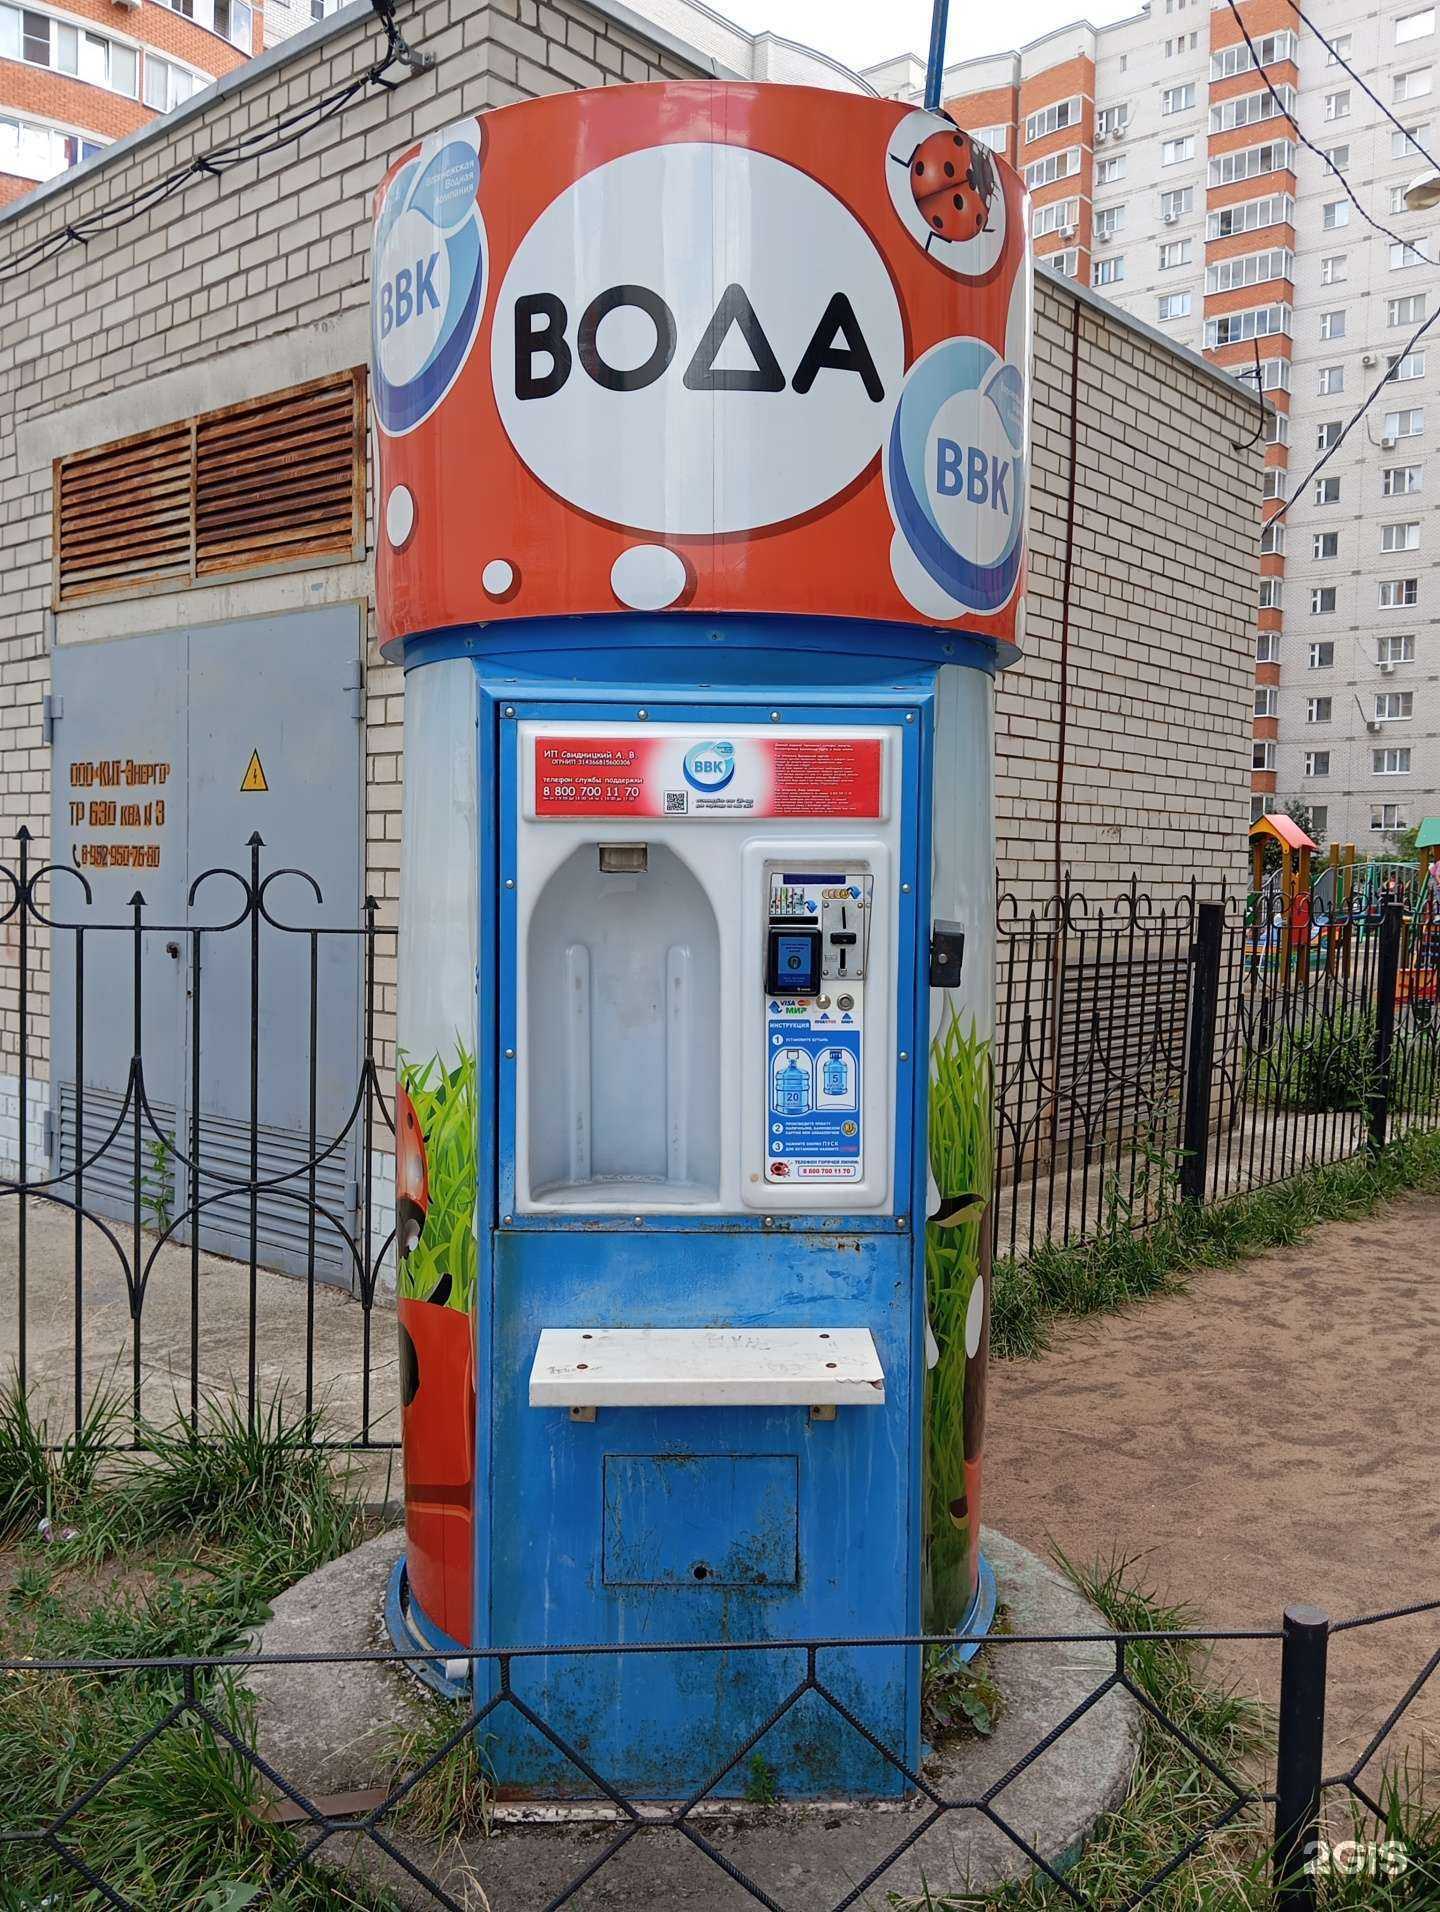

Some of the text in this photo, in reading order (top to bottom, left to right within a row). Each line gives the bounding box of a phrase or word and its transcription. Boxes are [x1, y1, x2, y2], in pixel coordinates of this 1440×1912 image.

[381, 252, 441, 340] ВВК
[514, 283, 886, 403] ВОДА
[937, 438, 1009, 515] ВВК
[544, 750, 558, 758] ИП
[694, 761, 723, 773] ВВК
[543, 777, 573, 786] телефон
[575, 776, 602, 785] службы
[543, 786, 641, 797] 8 800 700 11 70
[832, 1074, 839, 1083] 5
[786, 1092, 799, 1102] 20
